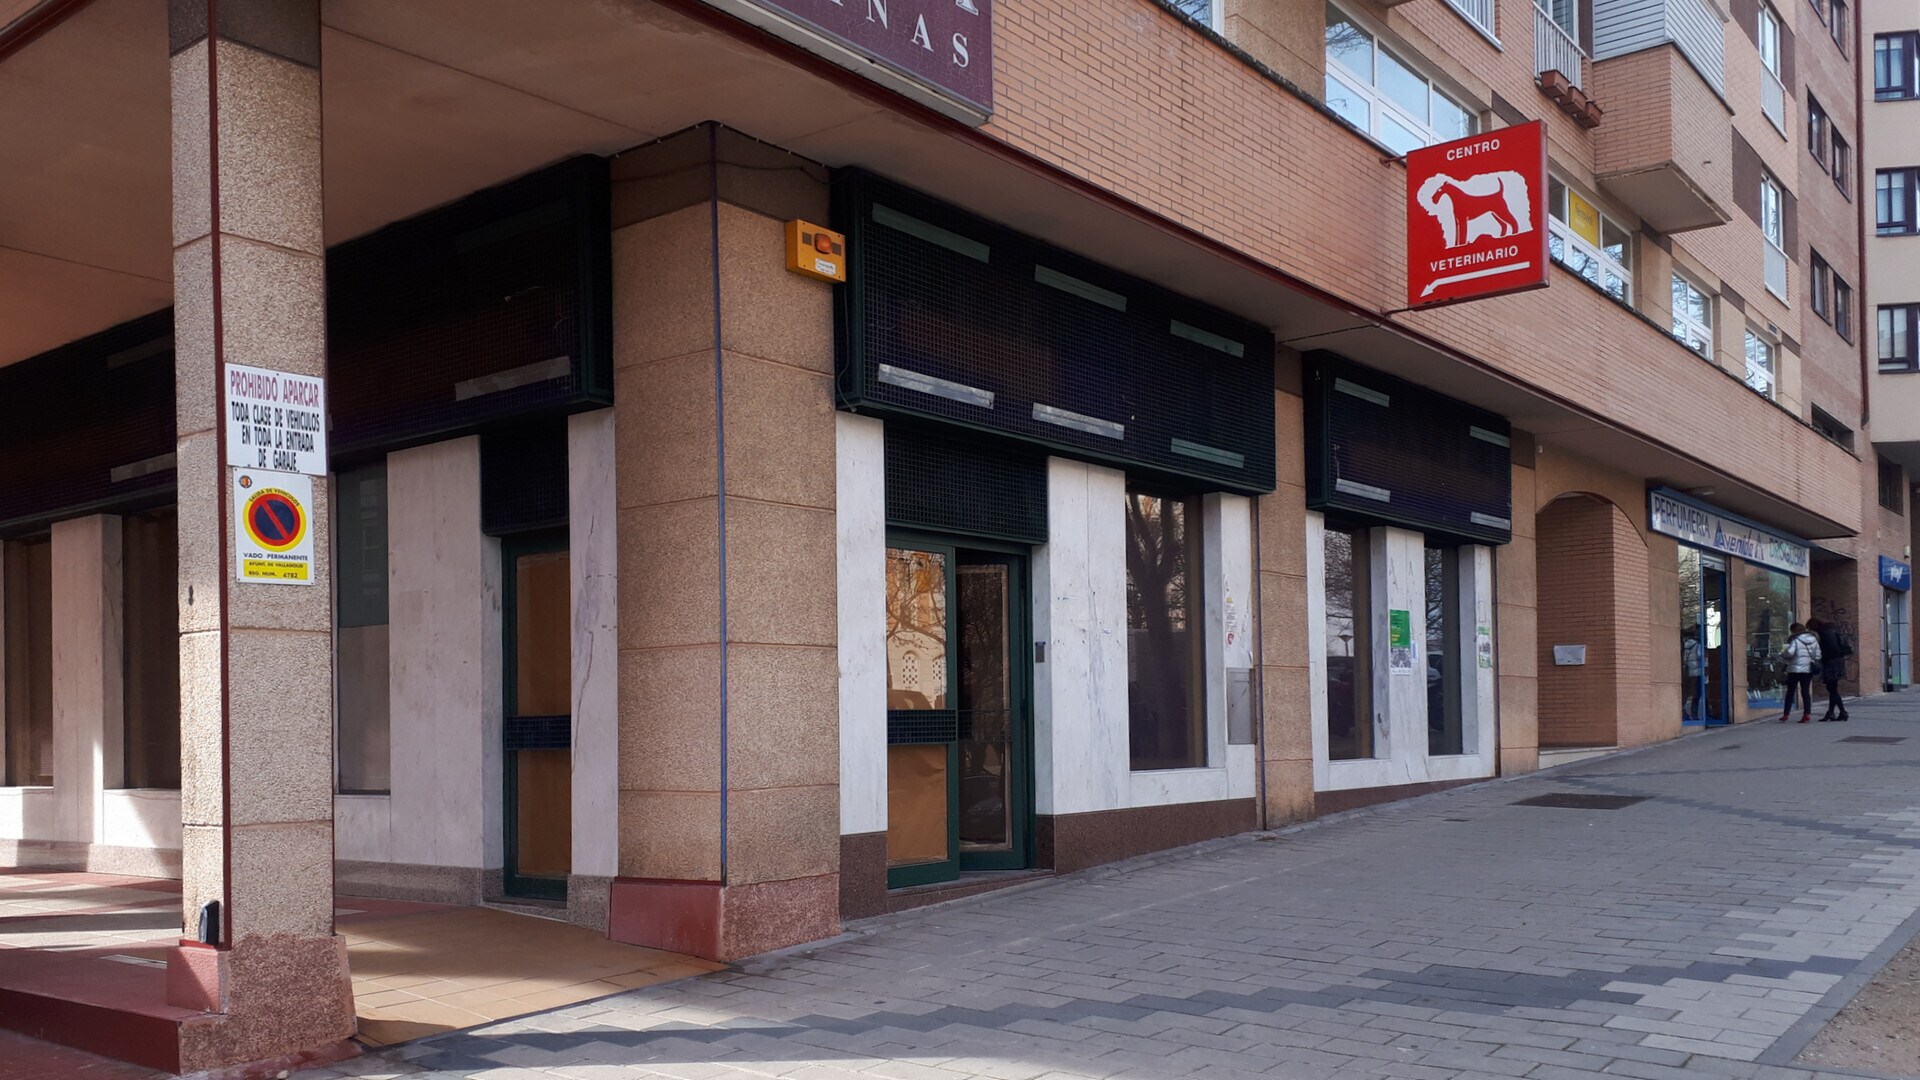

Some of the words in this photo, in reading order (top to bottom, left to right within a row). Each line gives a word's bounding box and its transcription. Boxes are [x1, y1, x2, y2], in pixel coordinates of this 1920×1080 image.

[830, 0, 970, 68] NAS
[1446, 139, 1501, 161] CENTRO
[1430, 245, 1518, 272] VETERINARIO
[230, 370, 278, 402] PROHIBIDO
[283, 379, 319, 408] APARCAR
[232, 401, 250, 423] TODA
[253, 404, 271, 426] CLASE
[275, 407, 283, 427] DE
[286, 409, 320, 432] VEHICULOS
[242, 424, 251, 444] EN
[254, 426, 272, 447] TODA
[275, 429, 283, 449] LA
[286, 430, 314, 453] ENTRADA
[258, 448, 266, 468] DE
[273, 449, 297, 471] GARAJE
[249, 488, 265, 502] SALIDA
[274, 488, 300, 506] VEHICULOS
[1654, 496, 1711, 539] PERFUMERIA
[267, 553, 308, 561] PERMANENTE
